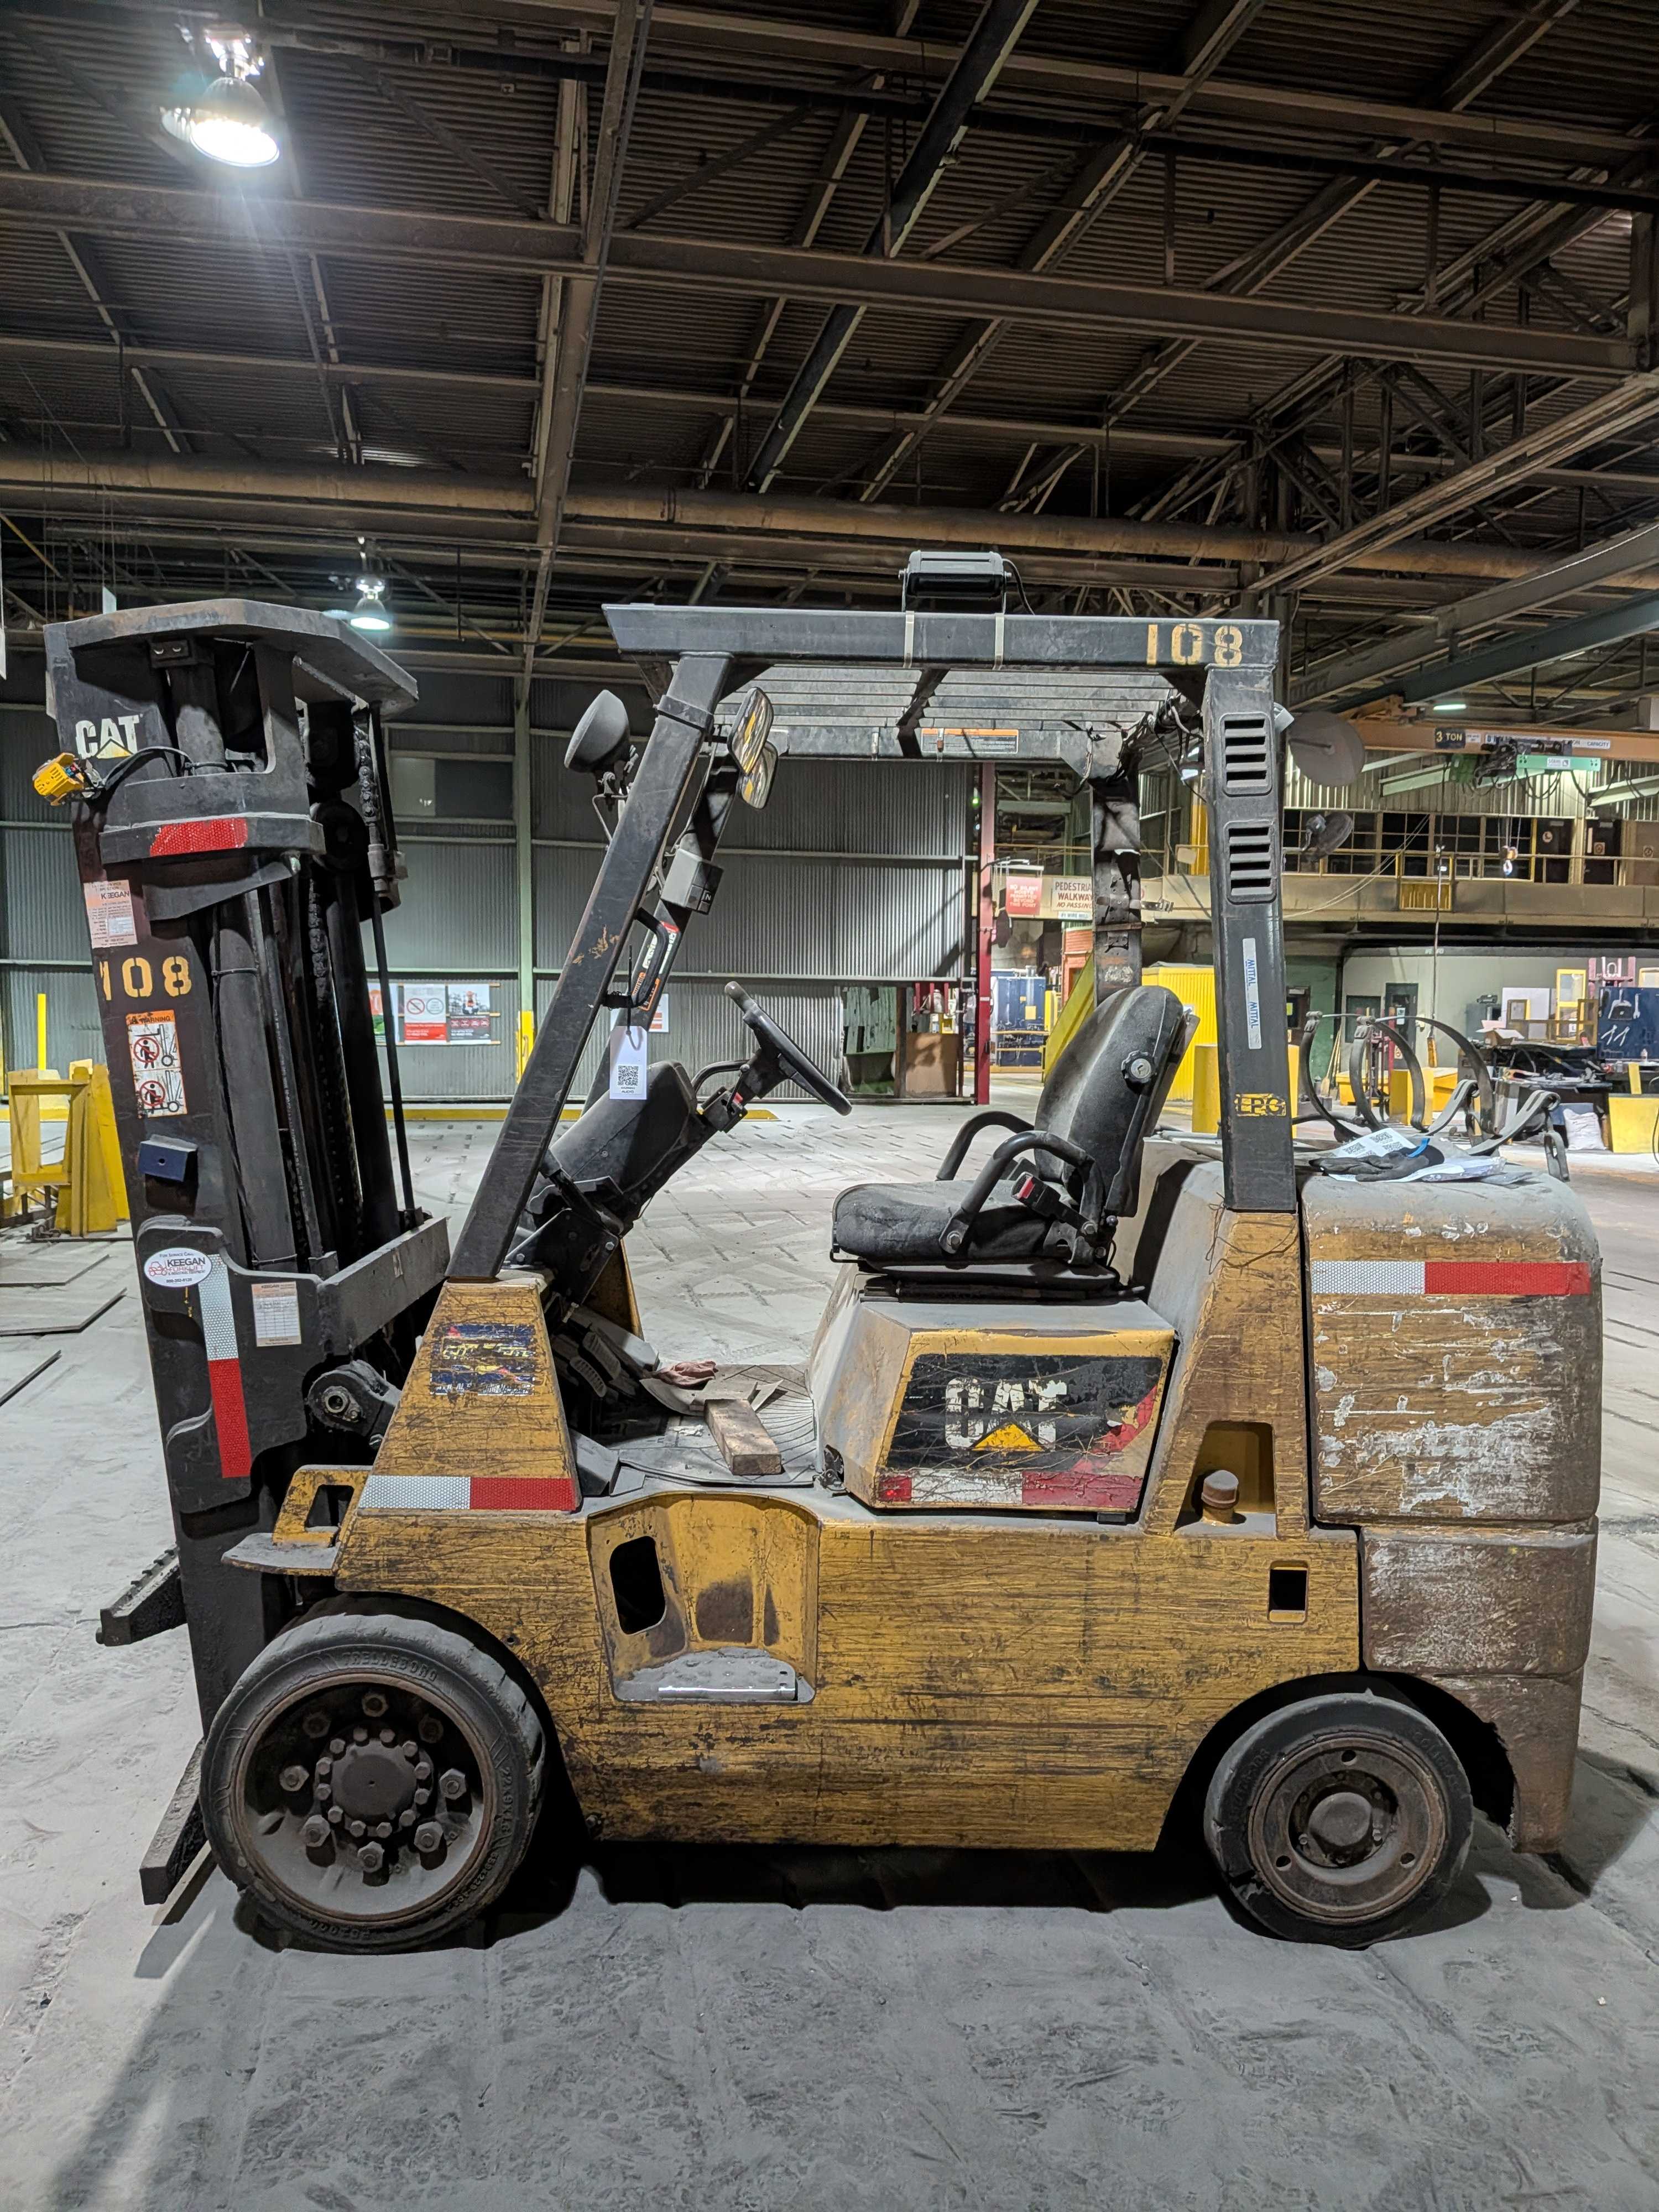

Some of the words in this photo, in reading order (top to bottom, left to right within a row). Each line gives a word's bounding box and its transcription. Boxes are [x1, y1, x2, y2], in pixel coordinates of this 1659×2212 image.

[1146, 623, 1243, 667] 108
[75, 714, 140, 760] CAT
[1436, 731, 1443, 742] 3
[1445, 732, 1463, 742] TON
[101, 891, 130, 900] KEEGAN
[1055, 881, 1092, 891] PEDESTRIA
[100, 956, 192, 1000] 108
[1247, 959, 1256, 987] MITTAL
[1249, 1001, 1259, 1029] MITTAL
[1237, 1097, 1285, 1114] LPG
[168, 1257, 206, 1267] KEEGAN
[945, 1377, 1067, 1452] CAT
